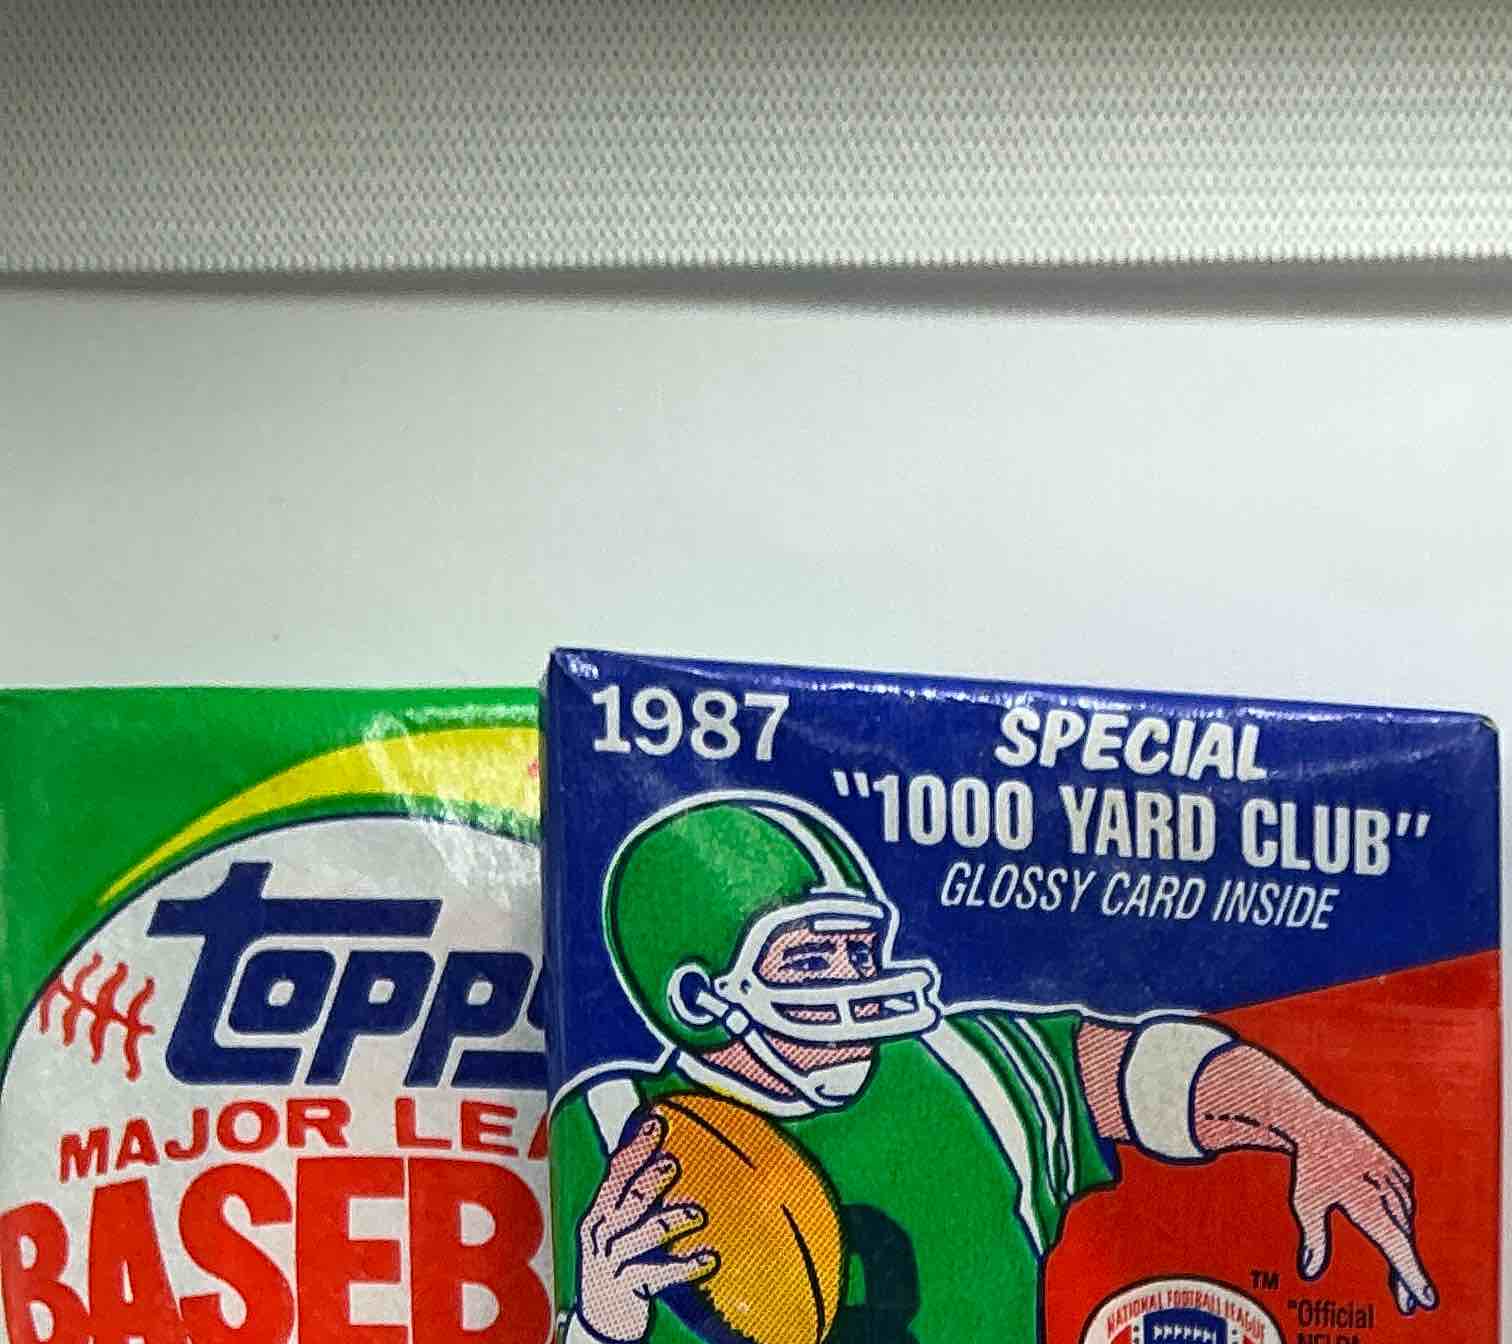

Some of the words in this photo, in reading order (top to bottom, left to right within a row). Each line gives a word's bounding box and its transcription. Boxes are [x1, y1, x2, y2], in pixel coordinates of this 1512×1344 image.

[592, 684, 790, 763] 1987
[995, 704, 1269, 783] SPECIAL
[1061, 785, 1218, 862] YARD
[1241, 803, 1432, 877] CLUB"
[940, 862, 1095, 913] GLOSSY
[1101, 872, 1205, 922] CARD
[1214, 879, 1340, 931] INSIDE
[59, 1099, 350, 1184] MAJOR
[1106, 1291, 1162, 1334] NATIONAL
